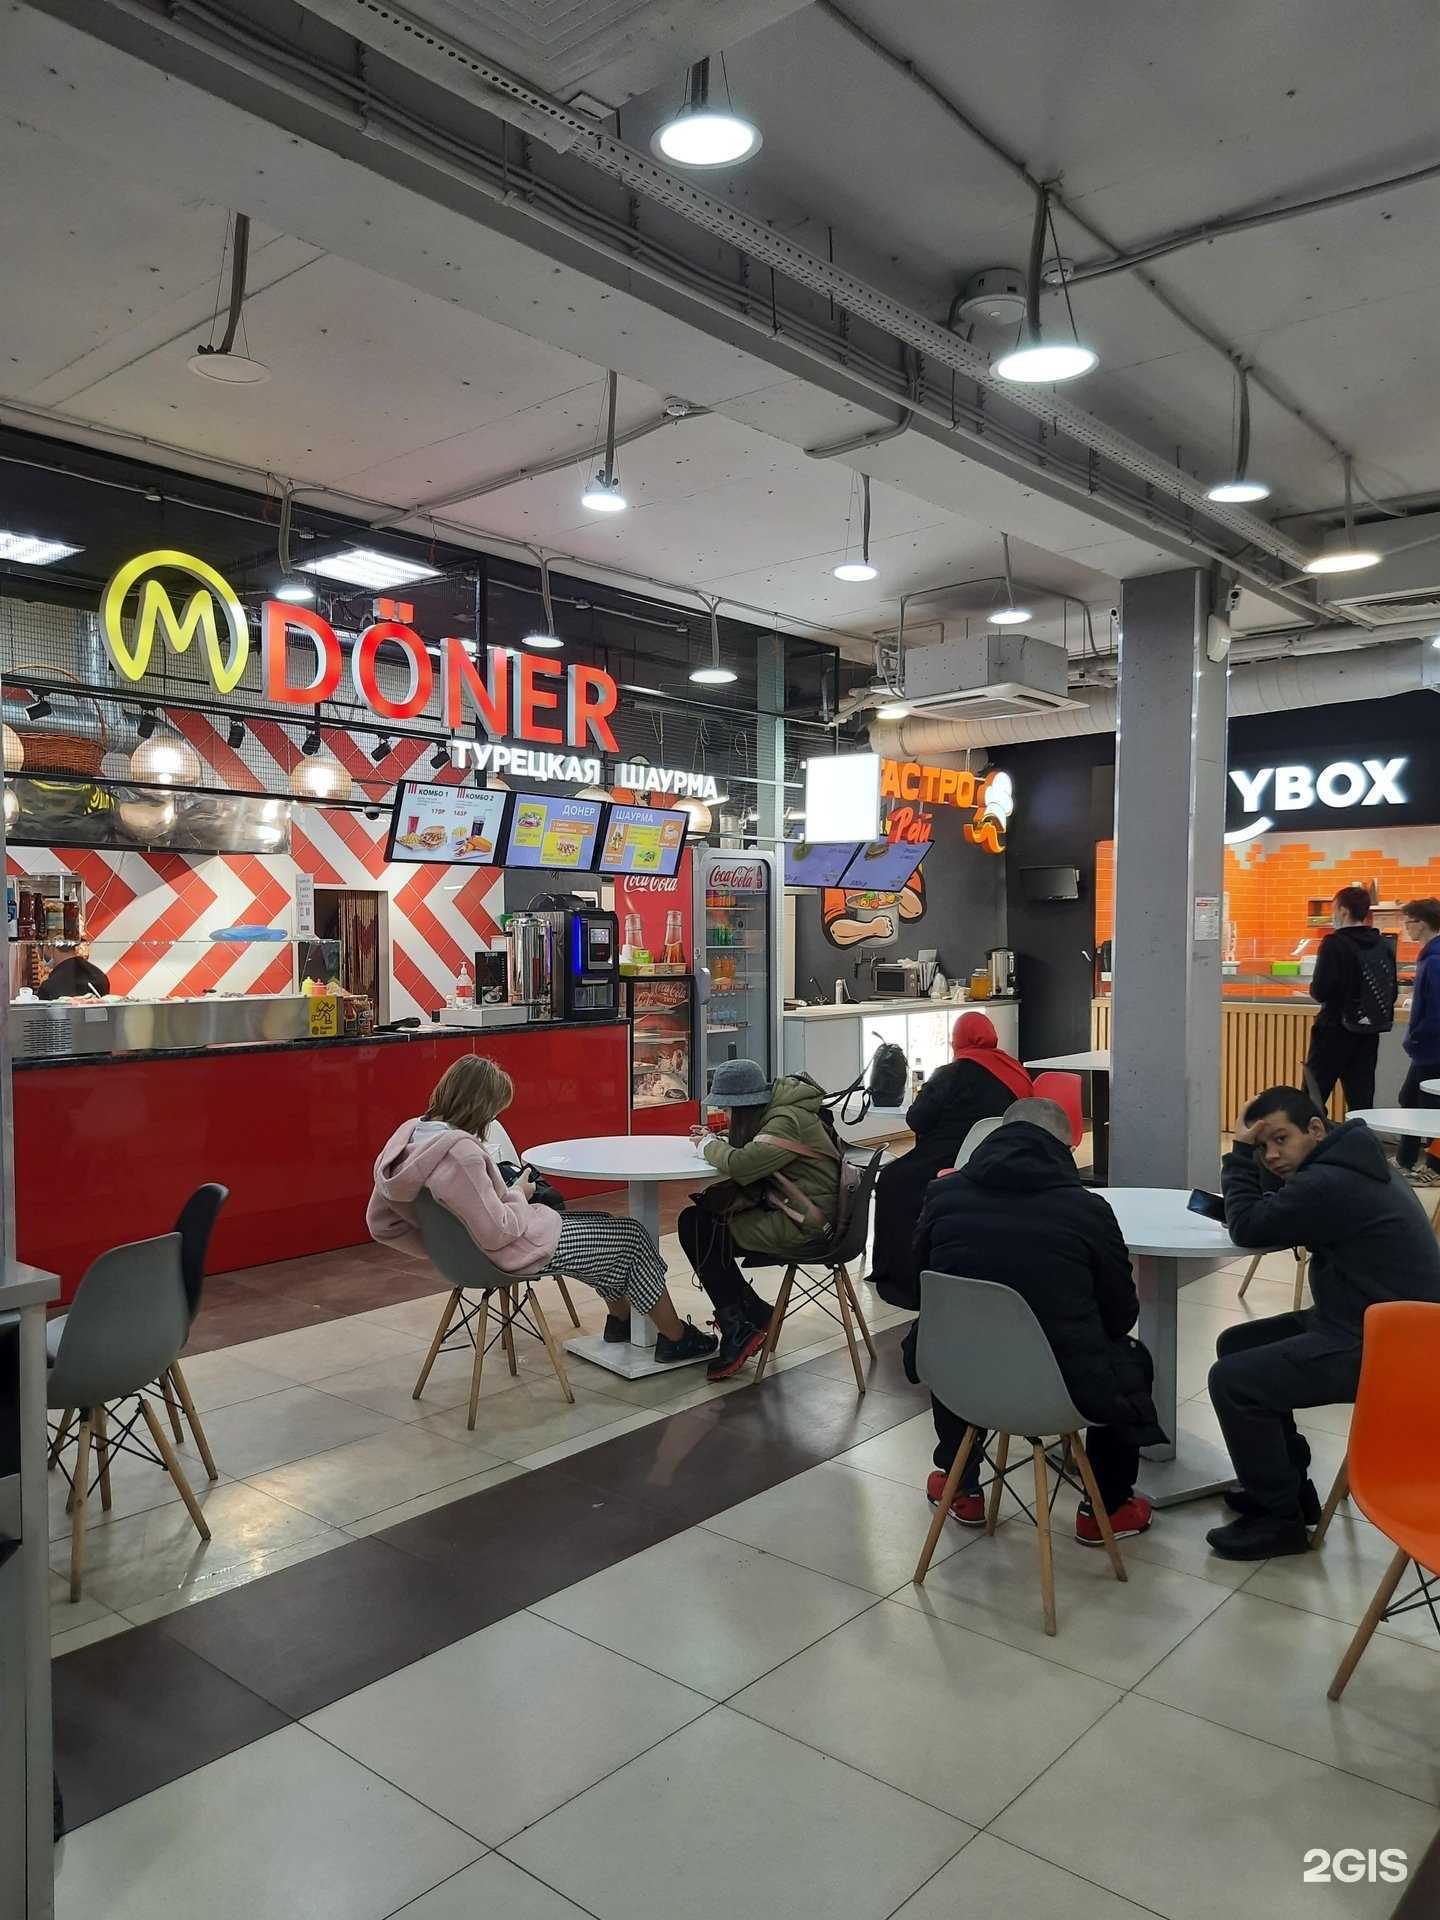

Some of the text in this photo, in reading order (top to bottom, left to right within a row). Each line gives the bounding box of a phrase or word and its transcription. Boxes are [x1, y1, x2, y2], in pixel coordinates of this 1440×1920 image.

[263, 599, 620, 753] DÖNER
[451, 740, 718, 799] ТУРЕЦКАЯ ШАУРМА
[879, 759, 975, 808] АСТРО
[1228, 758, 1408, 813] YBOX
[418, 789, 444, 798] КОМБО
[562, 804, 596, 817] ДОНЕР
[615, 809, 654, 823] ШАУРМА
[887, 806, 933, 844] Рай
